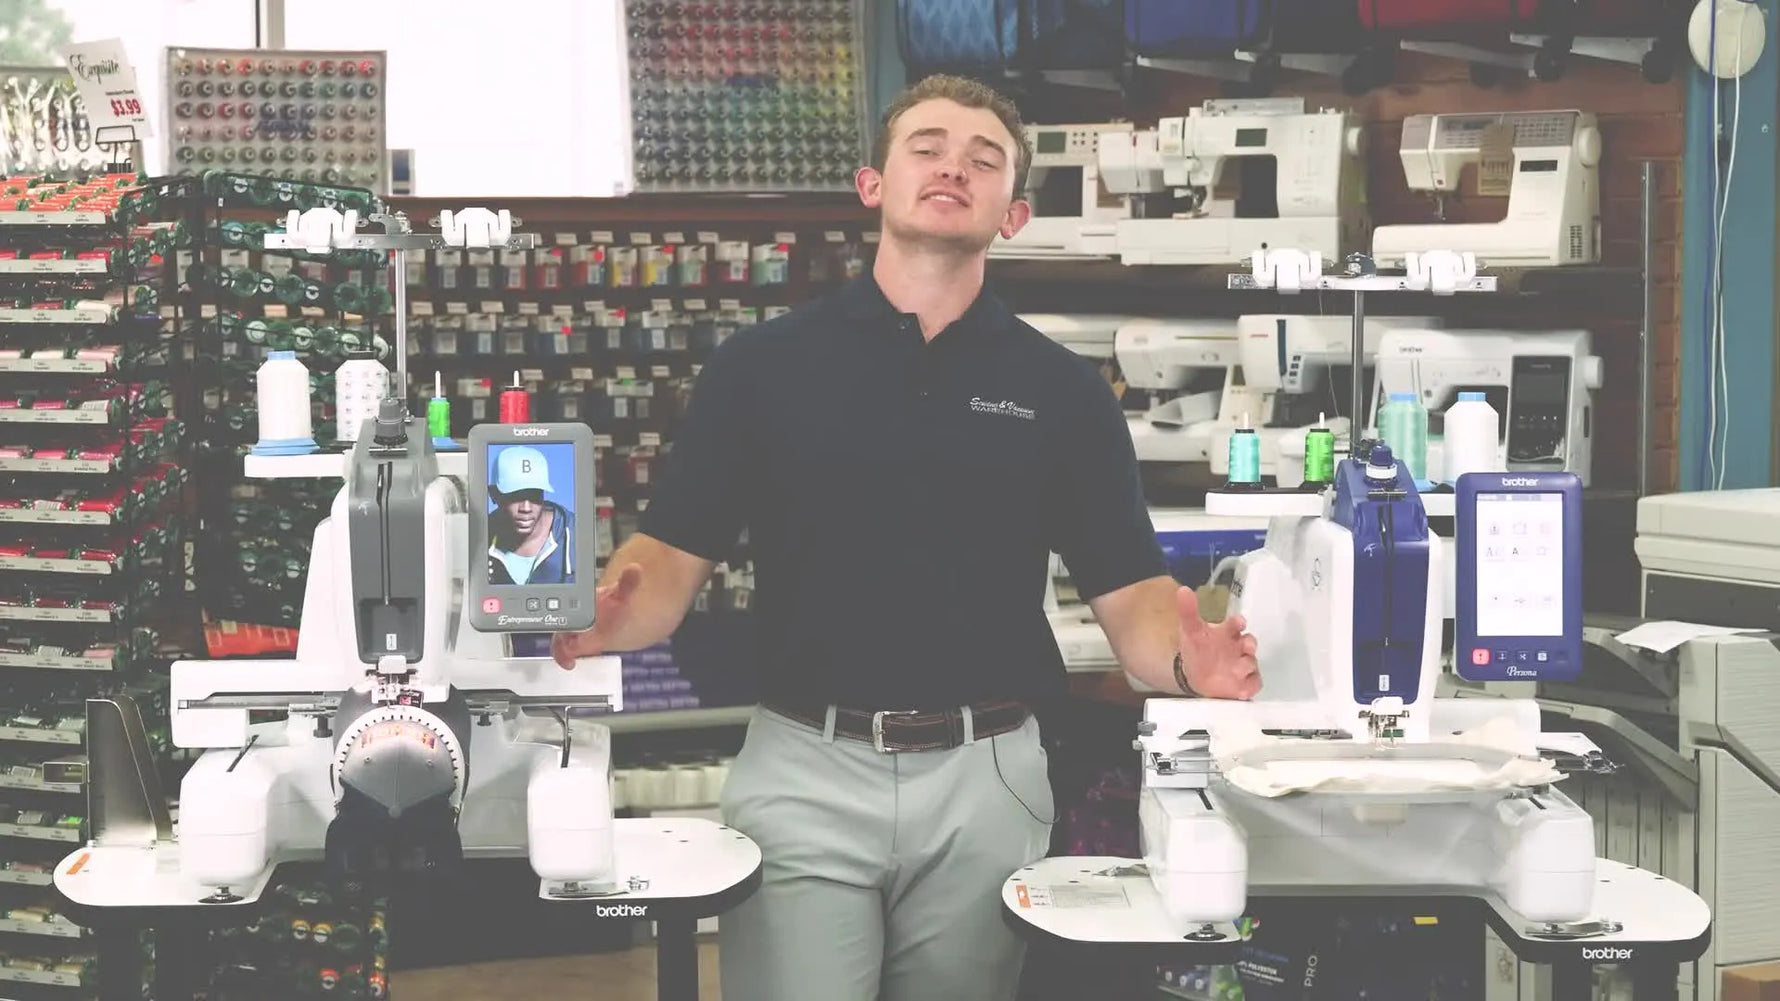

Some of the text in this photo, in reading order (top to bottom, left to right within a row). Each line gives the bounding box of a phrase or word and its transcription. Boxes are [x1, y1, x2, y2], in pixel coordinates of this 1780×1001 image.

[69, 54, 119, 85] Exquisite
[110, 99, 141, 117] $3.99
[999, 400, 1007, 409] &
[513, 427, 549, 437] brother
[522, 459, 532, 473] B
[1502, 477, 1539, 486] brother
[1506, 665, 1538, 677] Persona
[596, 904, 648, 917] brother
[1582, 946, 1633, 959] brother
[1303, 955, 1318, 987] PRO
